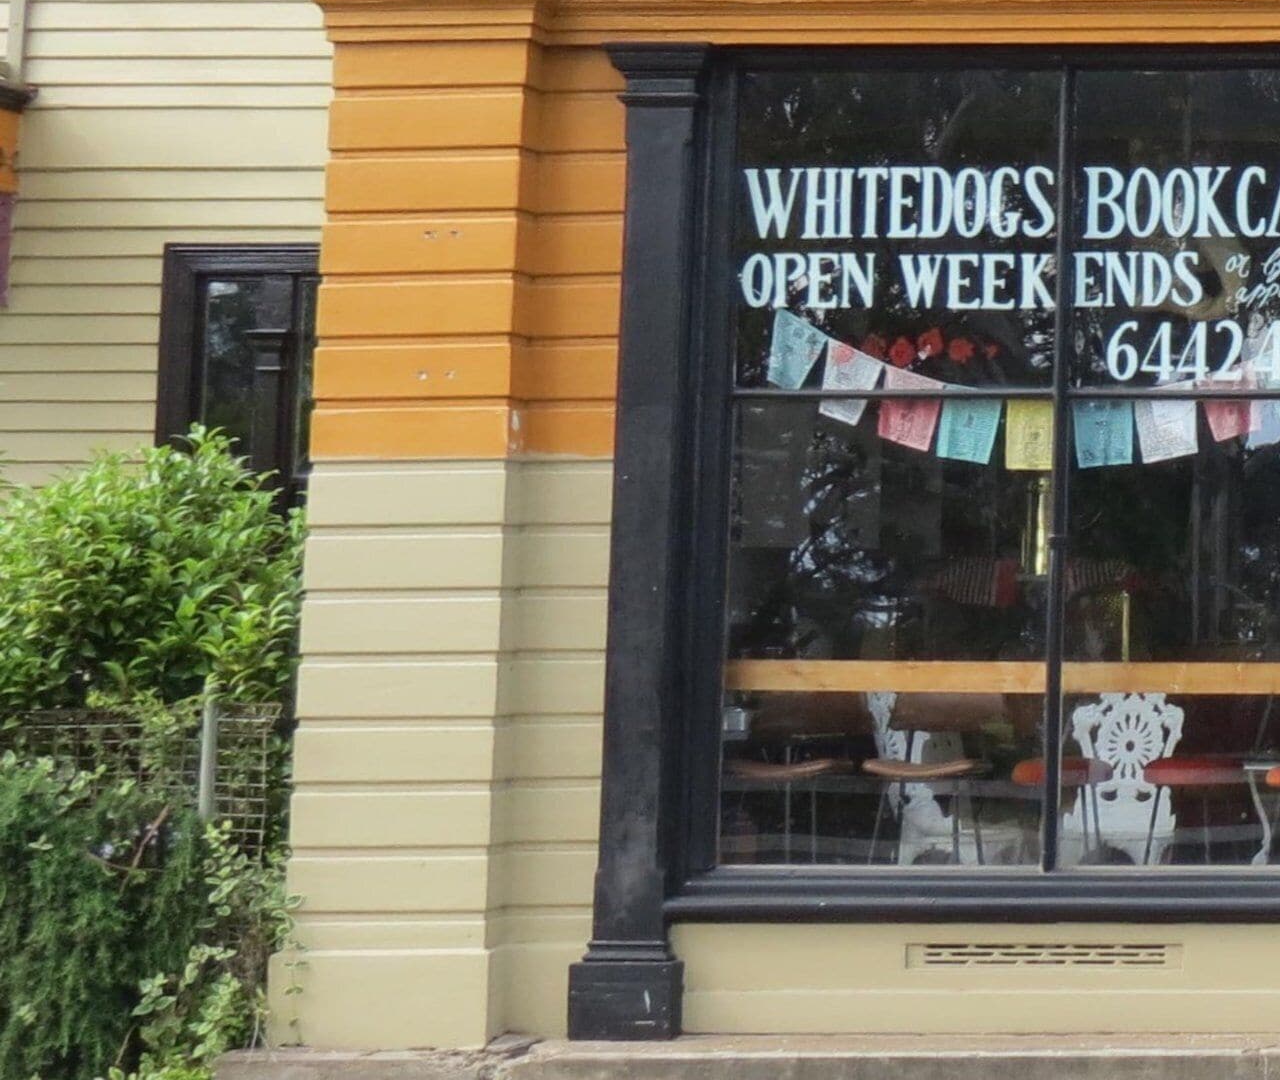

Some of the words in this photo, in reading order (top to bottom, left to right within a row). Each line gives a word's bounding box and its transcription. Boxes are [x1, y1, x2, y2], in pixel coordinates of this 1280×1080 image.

[744, 166, 1055, 239] WHITEDOGS
[740, 252, 877, 310] OPEN
[1225, 253, 1250, 277] or
[1107, 320, 1241, 382] 6442
